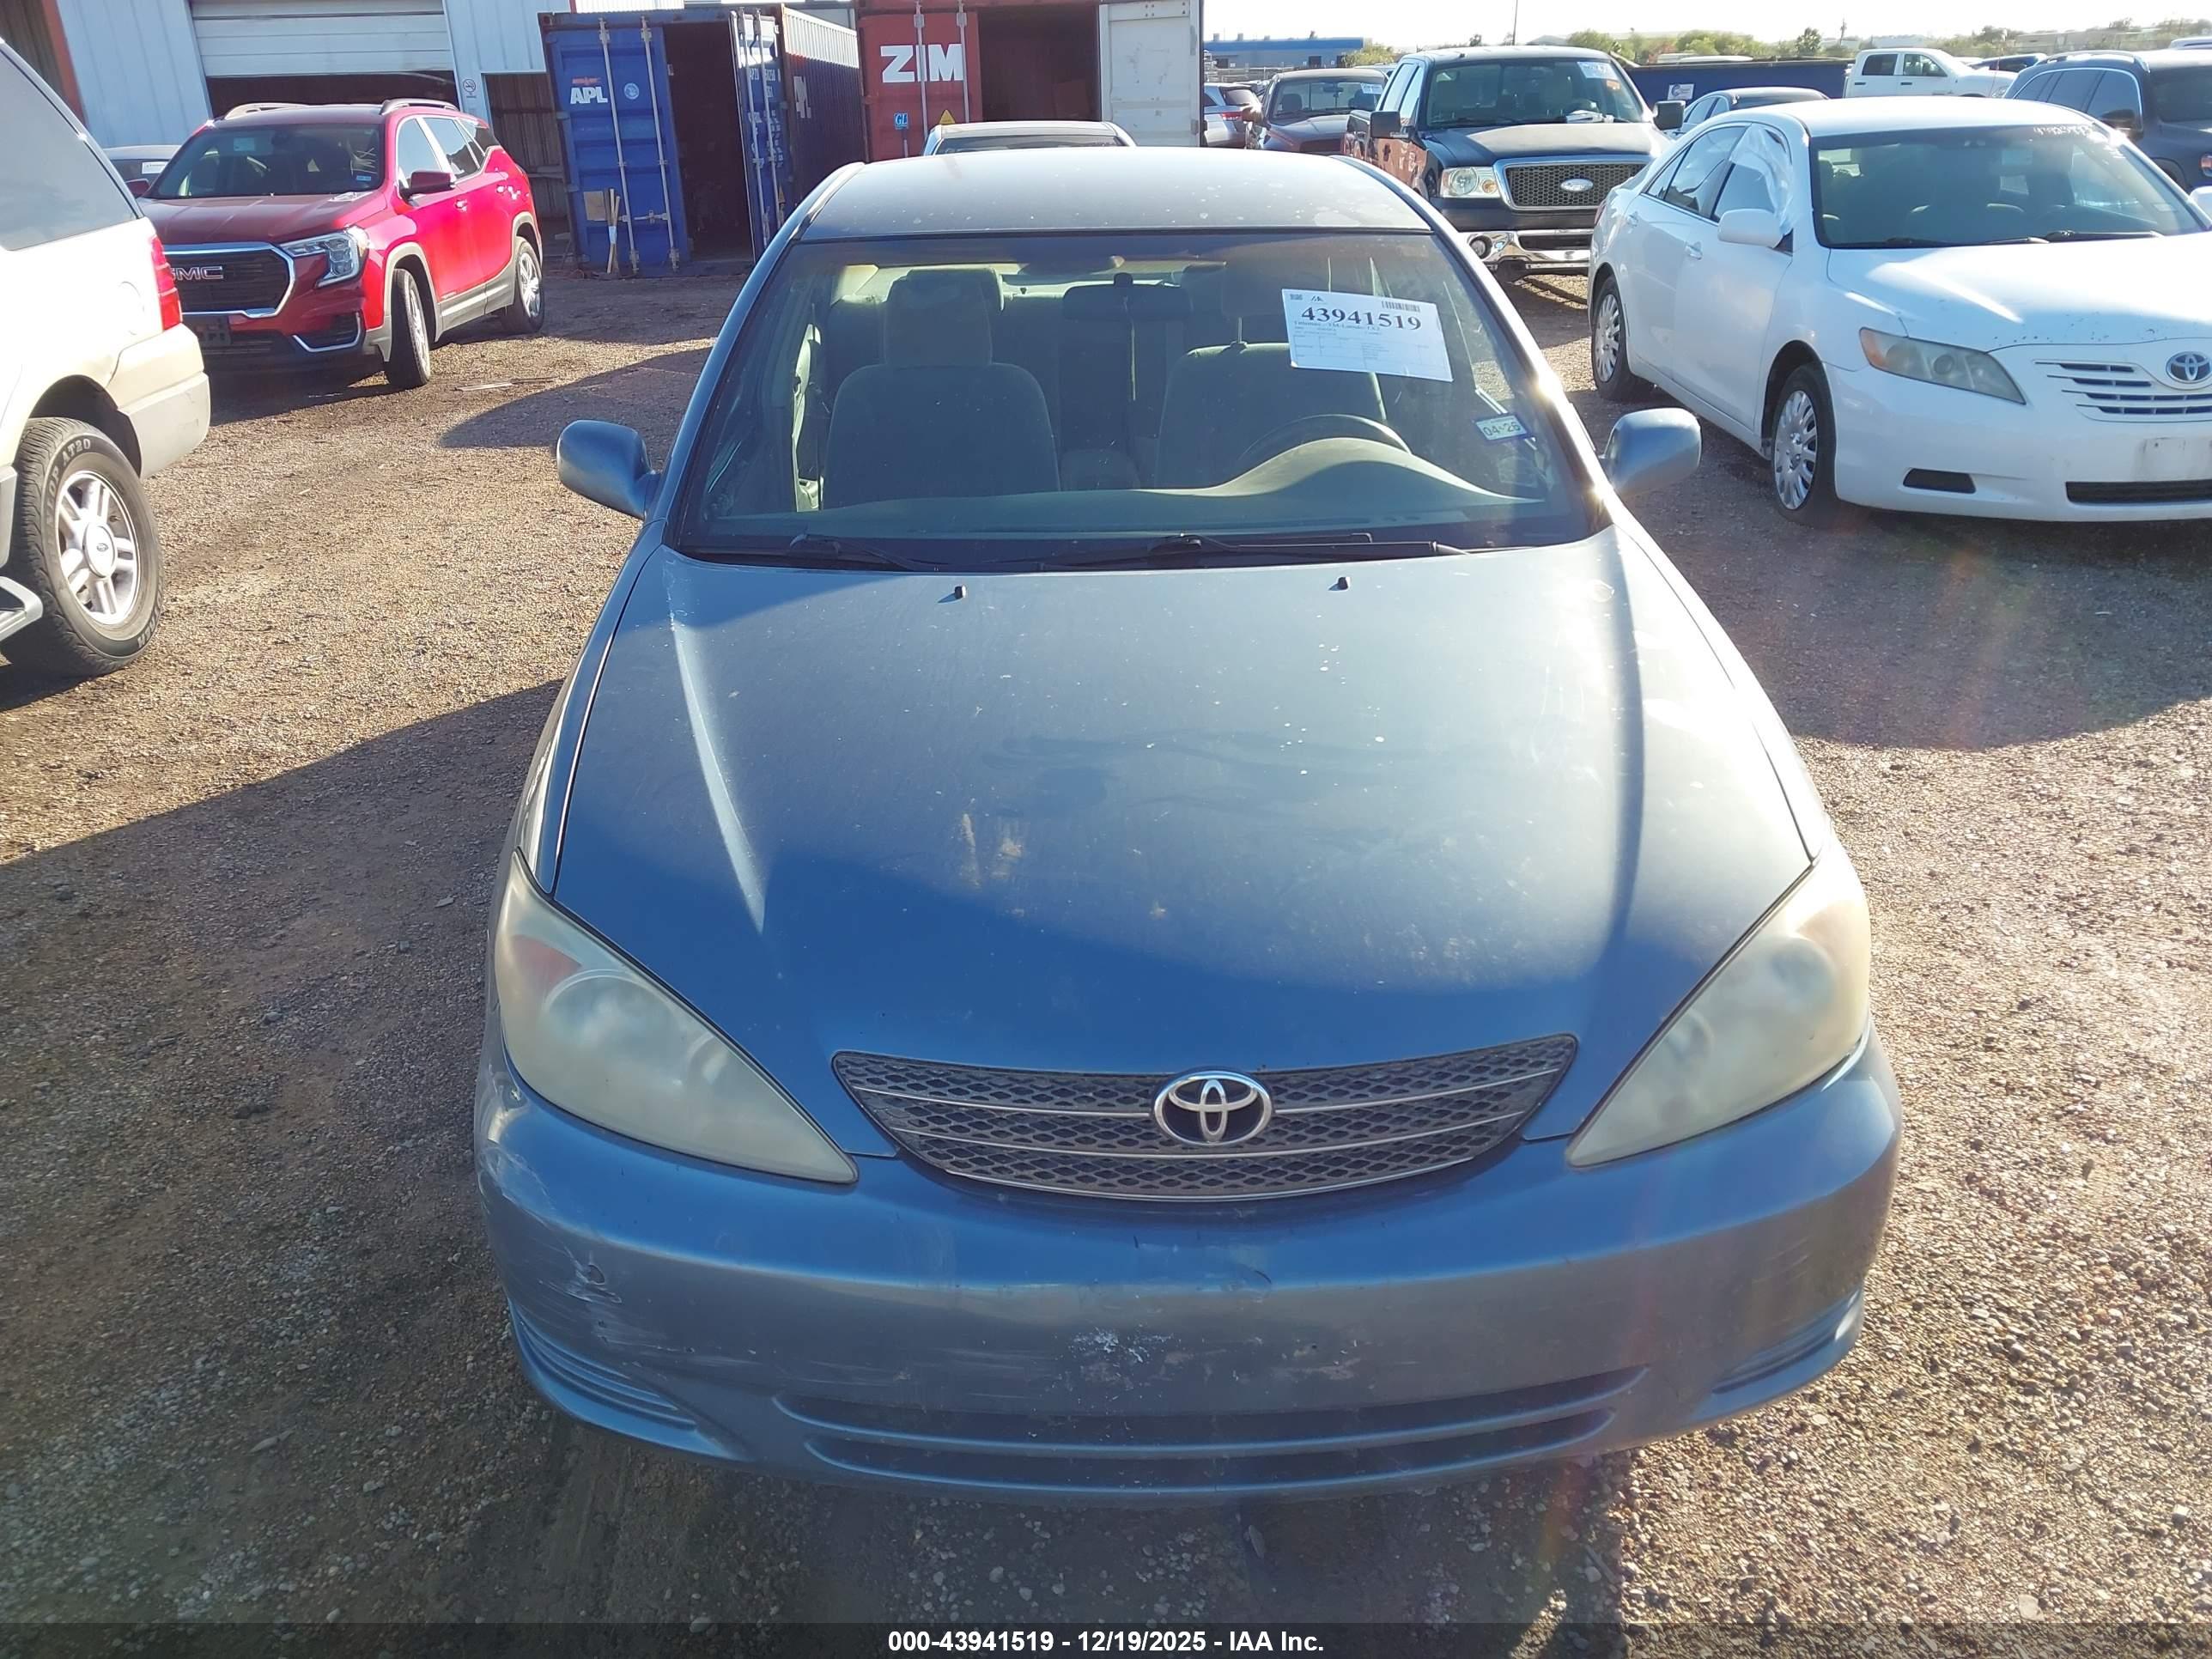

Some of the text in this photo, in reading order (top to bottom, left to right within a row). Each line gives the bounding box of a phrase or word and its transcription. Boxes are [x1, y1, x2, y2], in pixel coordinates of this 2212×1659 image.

[880, 44, 963, 82] ZIM
[570, 87, 608, 104] APL
[172, 266, 223, 281] MC
[1301, 307, 1421, 331] 43941519
[63, 438, 91, 467] AT20
